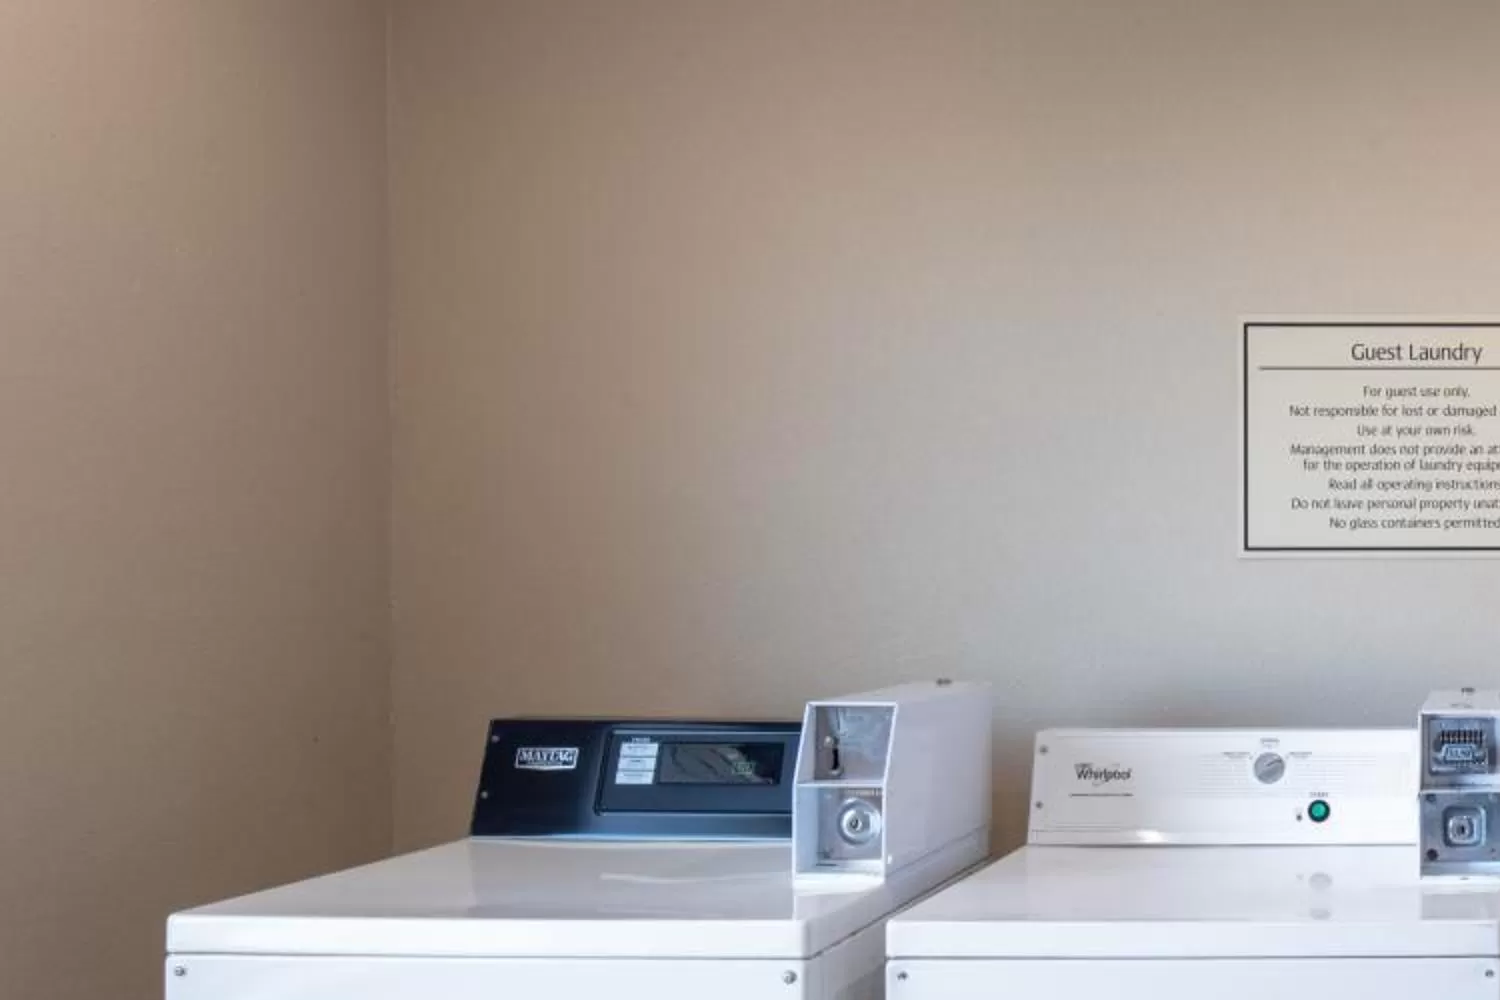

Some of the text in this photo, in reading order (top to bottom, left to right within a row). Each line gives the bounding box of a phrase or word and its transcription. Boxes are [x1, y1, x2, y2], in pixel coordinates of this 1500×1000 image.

[1351, 343, 1483, 365] Guest Laundry
[1363, 386, 1382, 397] For
[1386, 387, 1417, 400] guest
[1420, 388, 1440, 397] use
[1289, 405, 1310, 416] Not
[1313, 404, 1378, 418] responsible
[1382, 404, 1398, 416] for
[1402, 405, 1423, 416] lost
[1426, 408, 1439, 416] or
[1442, 404, 1497, 418] damaged
[1357, 425, 1377, 436] Use
[1381, 426, 1392, 435] at
[1396, 427, 1421, 438] your
[1426, 427, 1450, 435] own
[1290, 444, 1365, 457] Management
[1370, 444, 1396, 455] does
[1400, 445, 1419, 454] not
[1423, 444, 1466, 456] provide
[1470, 446, 1484, 455] an
[1303, 459, 1320, 471] for
[1323, 459, 1342, 470] the
[1345, 460, 1400, 472] operation
[1404, 459, 1415, 469] of
[1420, 460, 1462, 472] laundry
[1328, 478, 1357, 490] Read
[1360, 478, 1373, 489] all
[1376, 480, 1433, 492] operating
[1291, 497, 1309, 509] Do
[1311, 499, 1331, 509] not
[1333, 498, 1364, 509] leave
[1367, 498, 1417, 512] personal
[1419, 499, 1470, 512] property
[1329, 517, 1346, 528] No
[1350, 518, 1378, 530] glass
[1381, 518, 1441, 528] containers
[518, 749, 575, 762] MAYTAG
[1073, 762, 1133, 783] Whirlpool
